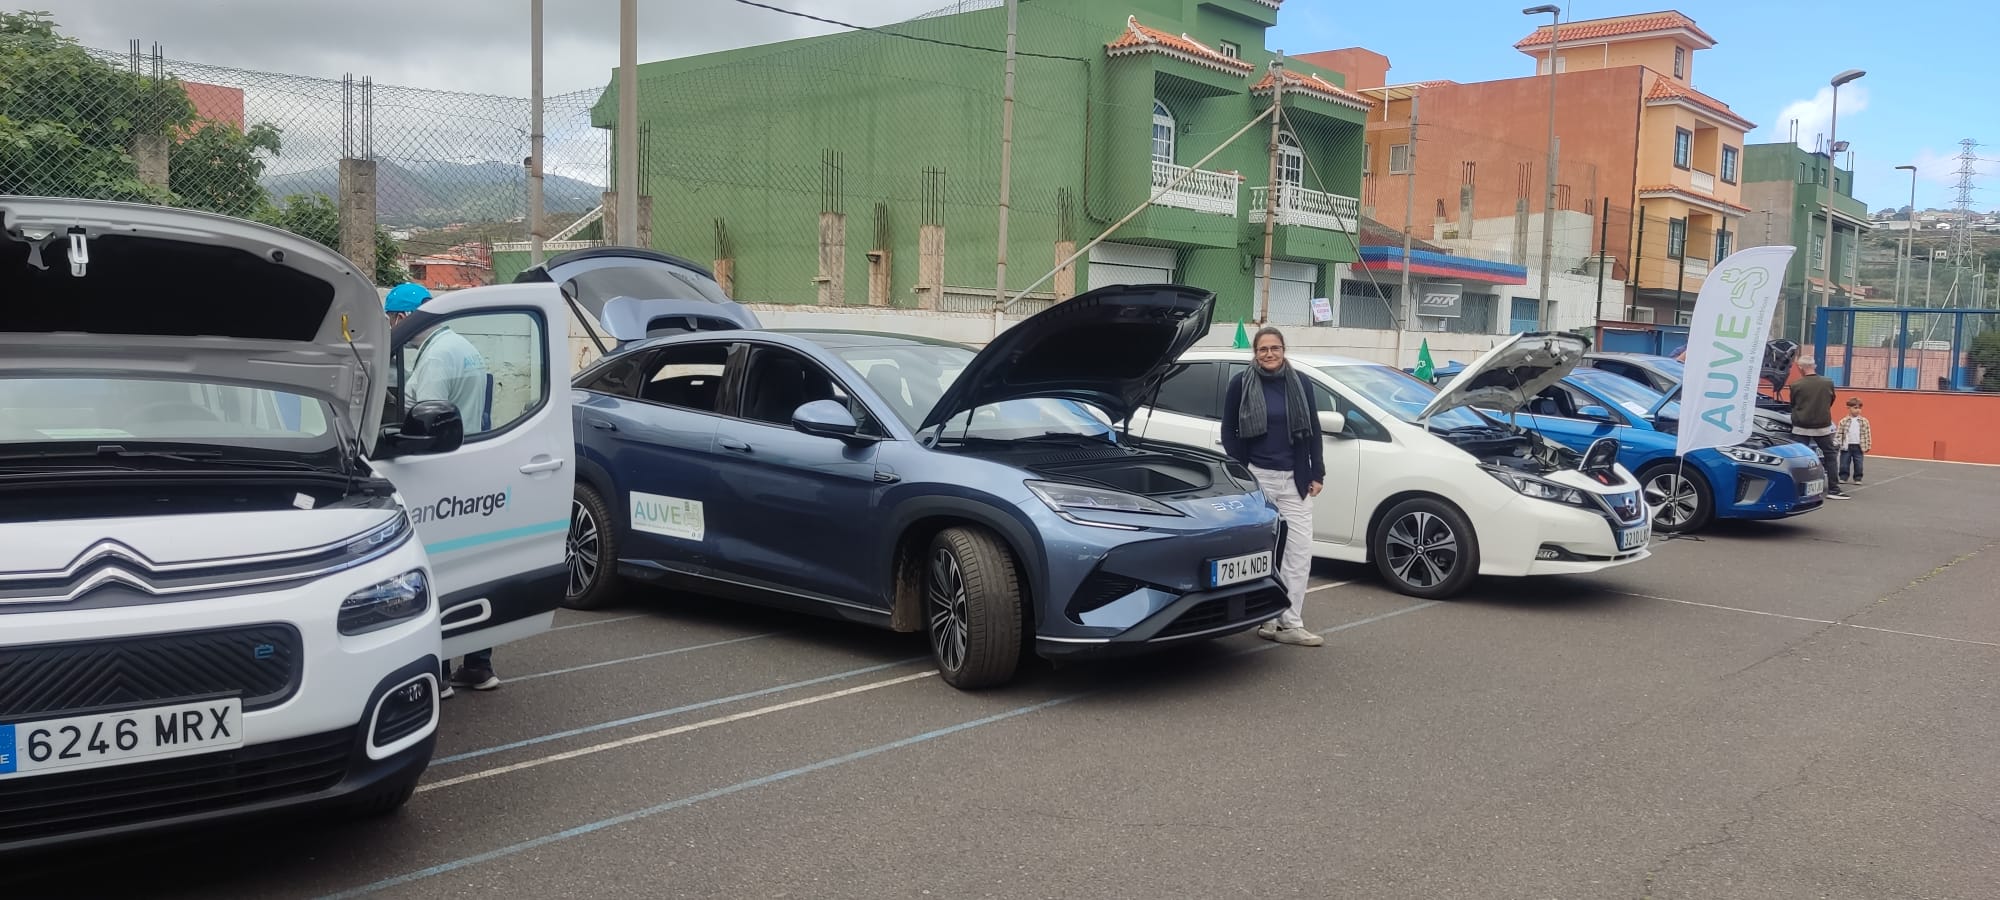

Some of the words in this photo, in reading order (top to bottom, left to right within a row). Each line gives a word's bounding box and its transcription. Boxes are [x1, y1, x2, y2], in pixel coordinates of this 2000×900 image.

[1423, 293, 1460, 306] TNR
[1701, 313, 1751, 432] AUVE
[410, 492, 506, 523] anCharge
[634, 501, 682, 525] AUVE
[1625, 530, 1640, 546] 3210
[1221, 560, 1247, 581] 7814
[1250, 556, 1268, 575] NDB
[28, 718, 138, 762] 6246
[155, 706, 231, 747] MRX
